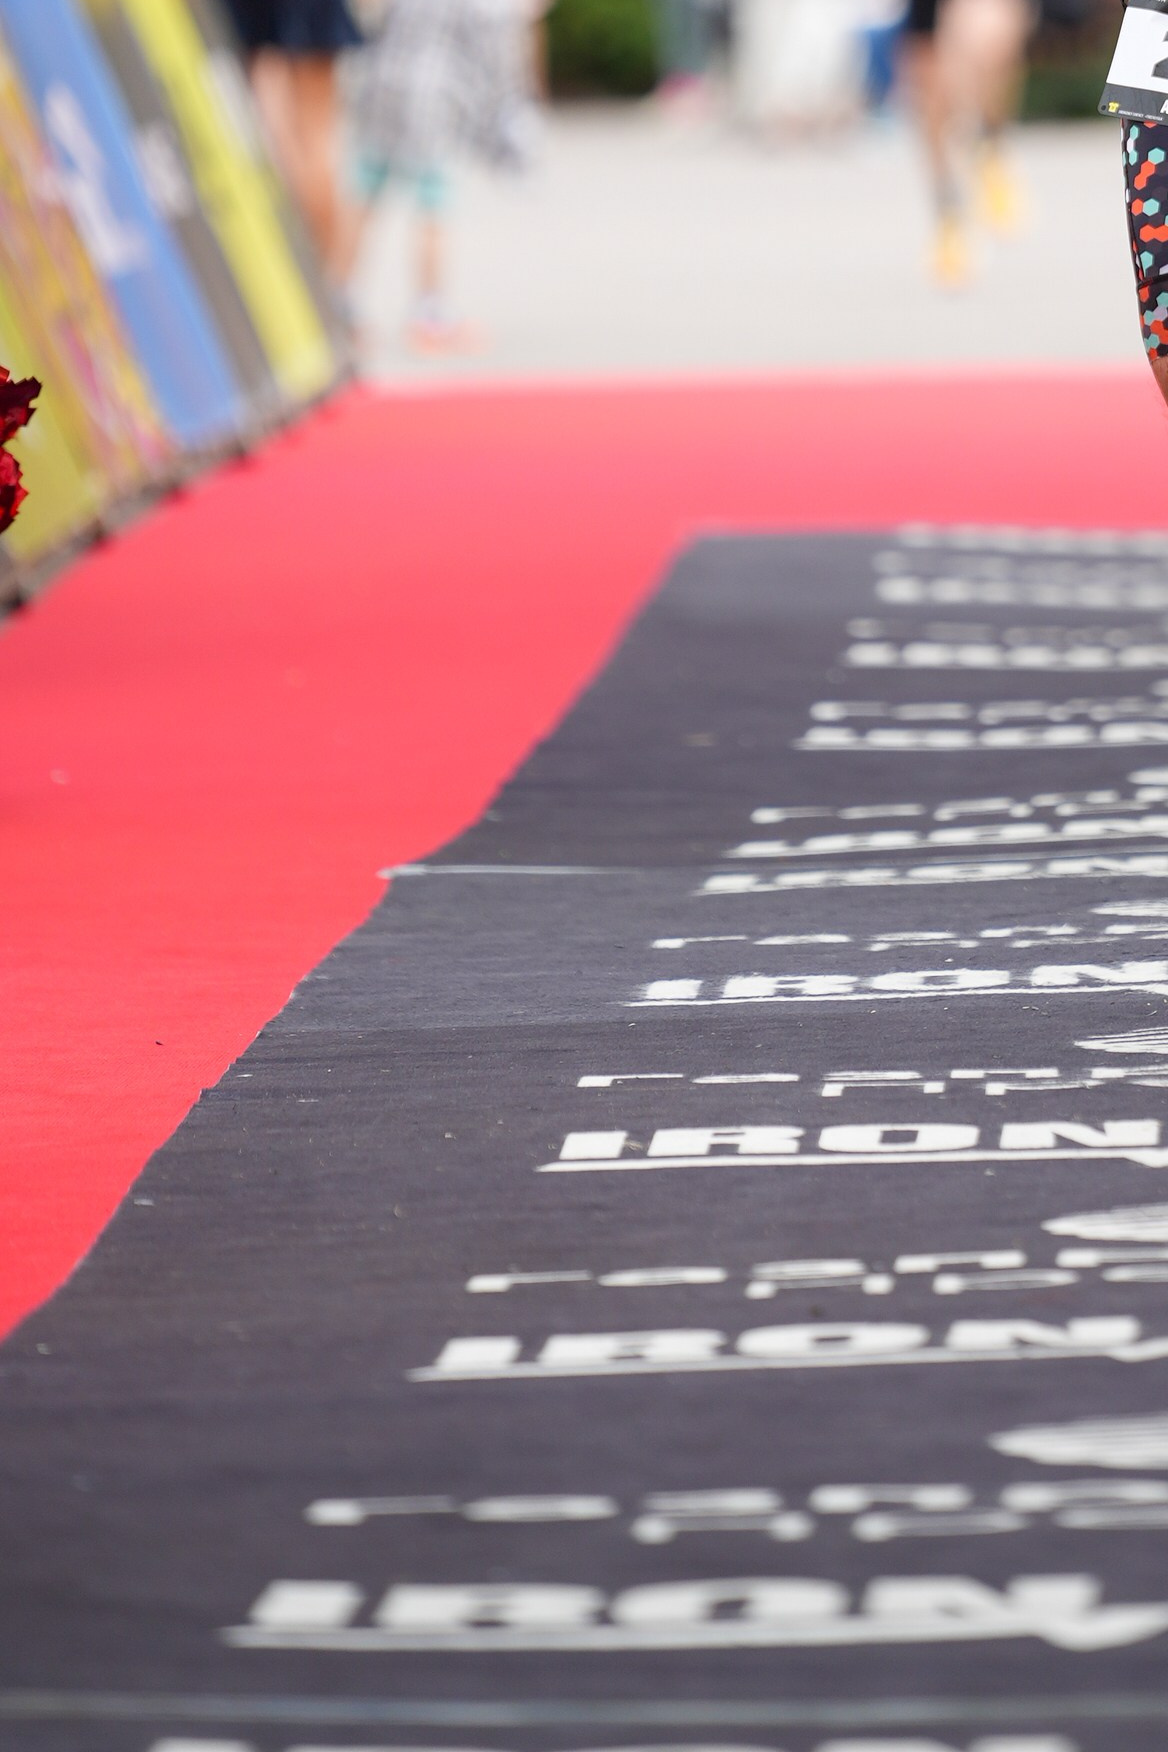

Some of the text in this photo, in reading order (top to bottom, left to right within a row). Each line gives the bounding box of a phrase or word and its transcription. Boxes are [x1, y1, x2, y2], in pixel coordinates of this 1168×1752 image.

[558, 1118, 1160, 1160] IRON
[438, 1315, 1138, 1371] IRON
[250, 1572, 1100, 1636] IRON
